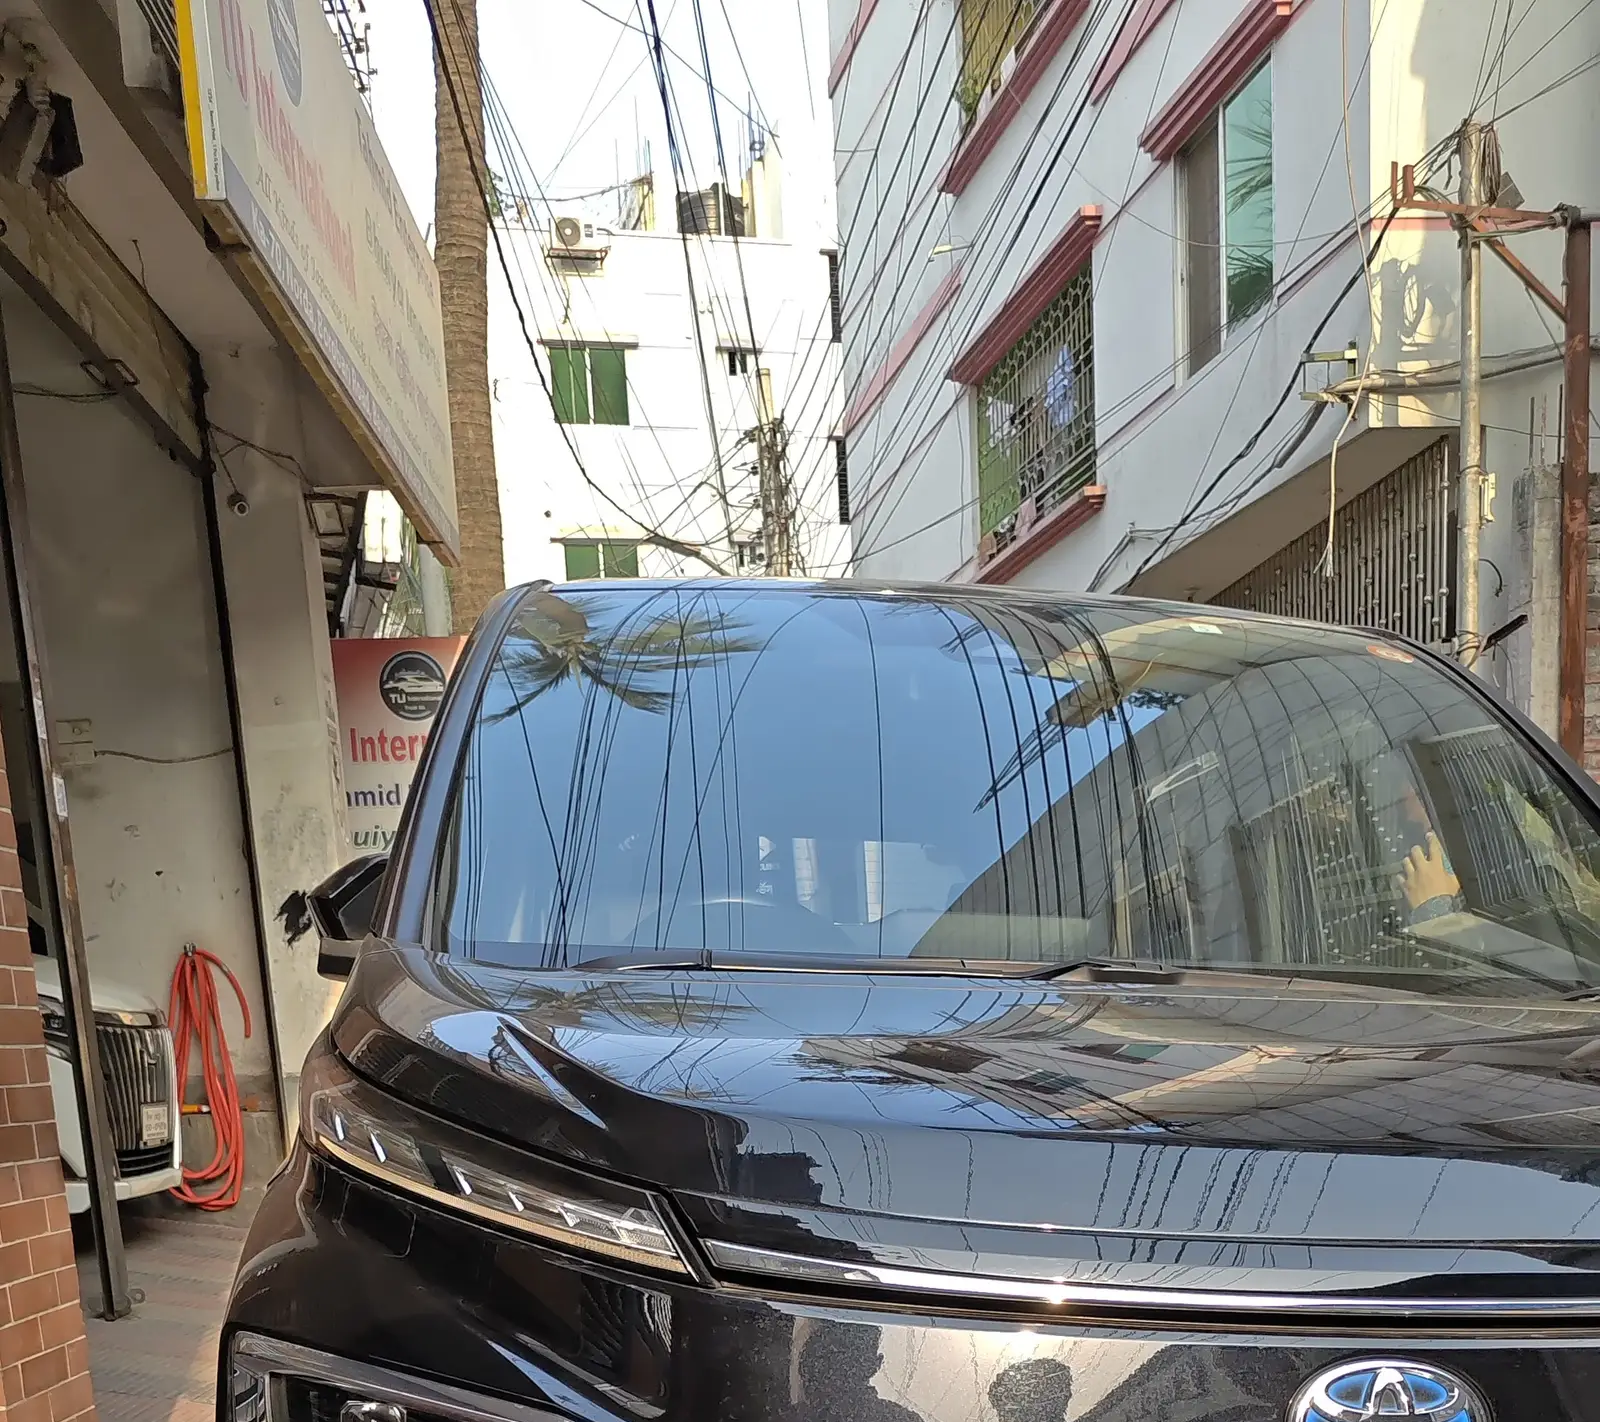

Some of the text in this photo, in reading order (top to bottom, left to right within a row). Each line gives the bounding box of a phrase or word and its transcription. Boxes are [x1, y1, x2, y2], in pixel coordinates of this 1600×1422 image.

[248, 23, 357, 301] International
[255, 162, 273, 204] All
[354, 107, 393, 217] Tahmid
[392, 193, 435, 307] Enterprise
[389, 693, 407, 704] TU
[346, 783, 402, 807] mid
[353, 824, 397, 852] uiy
